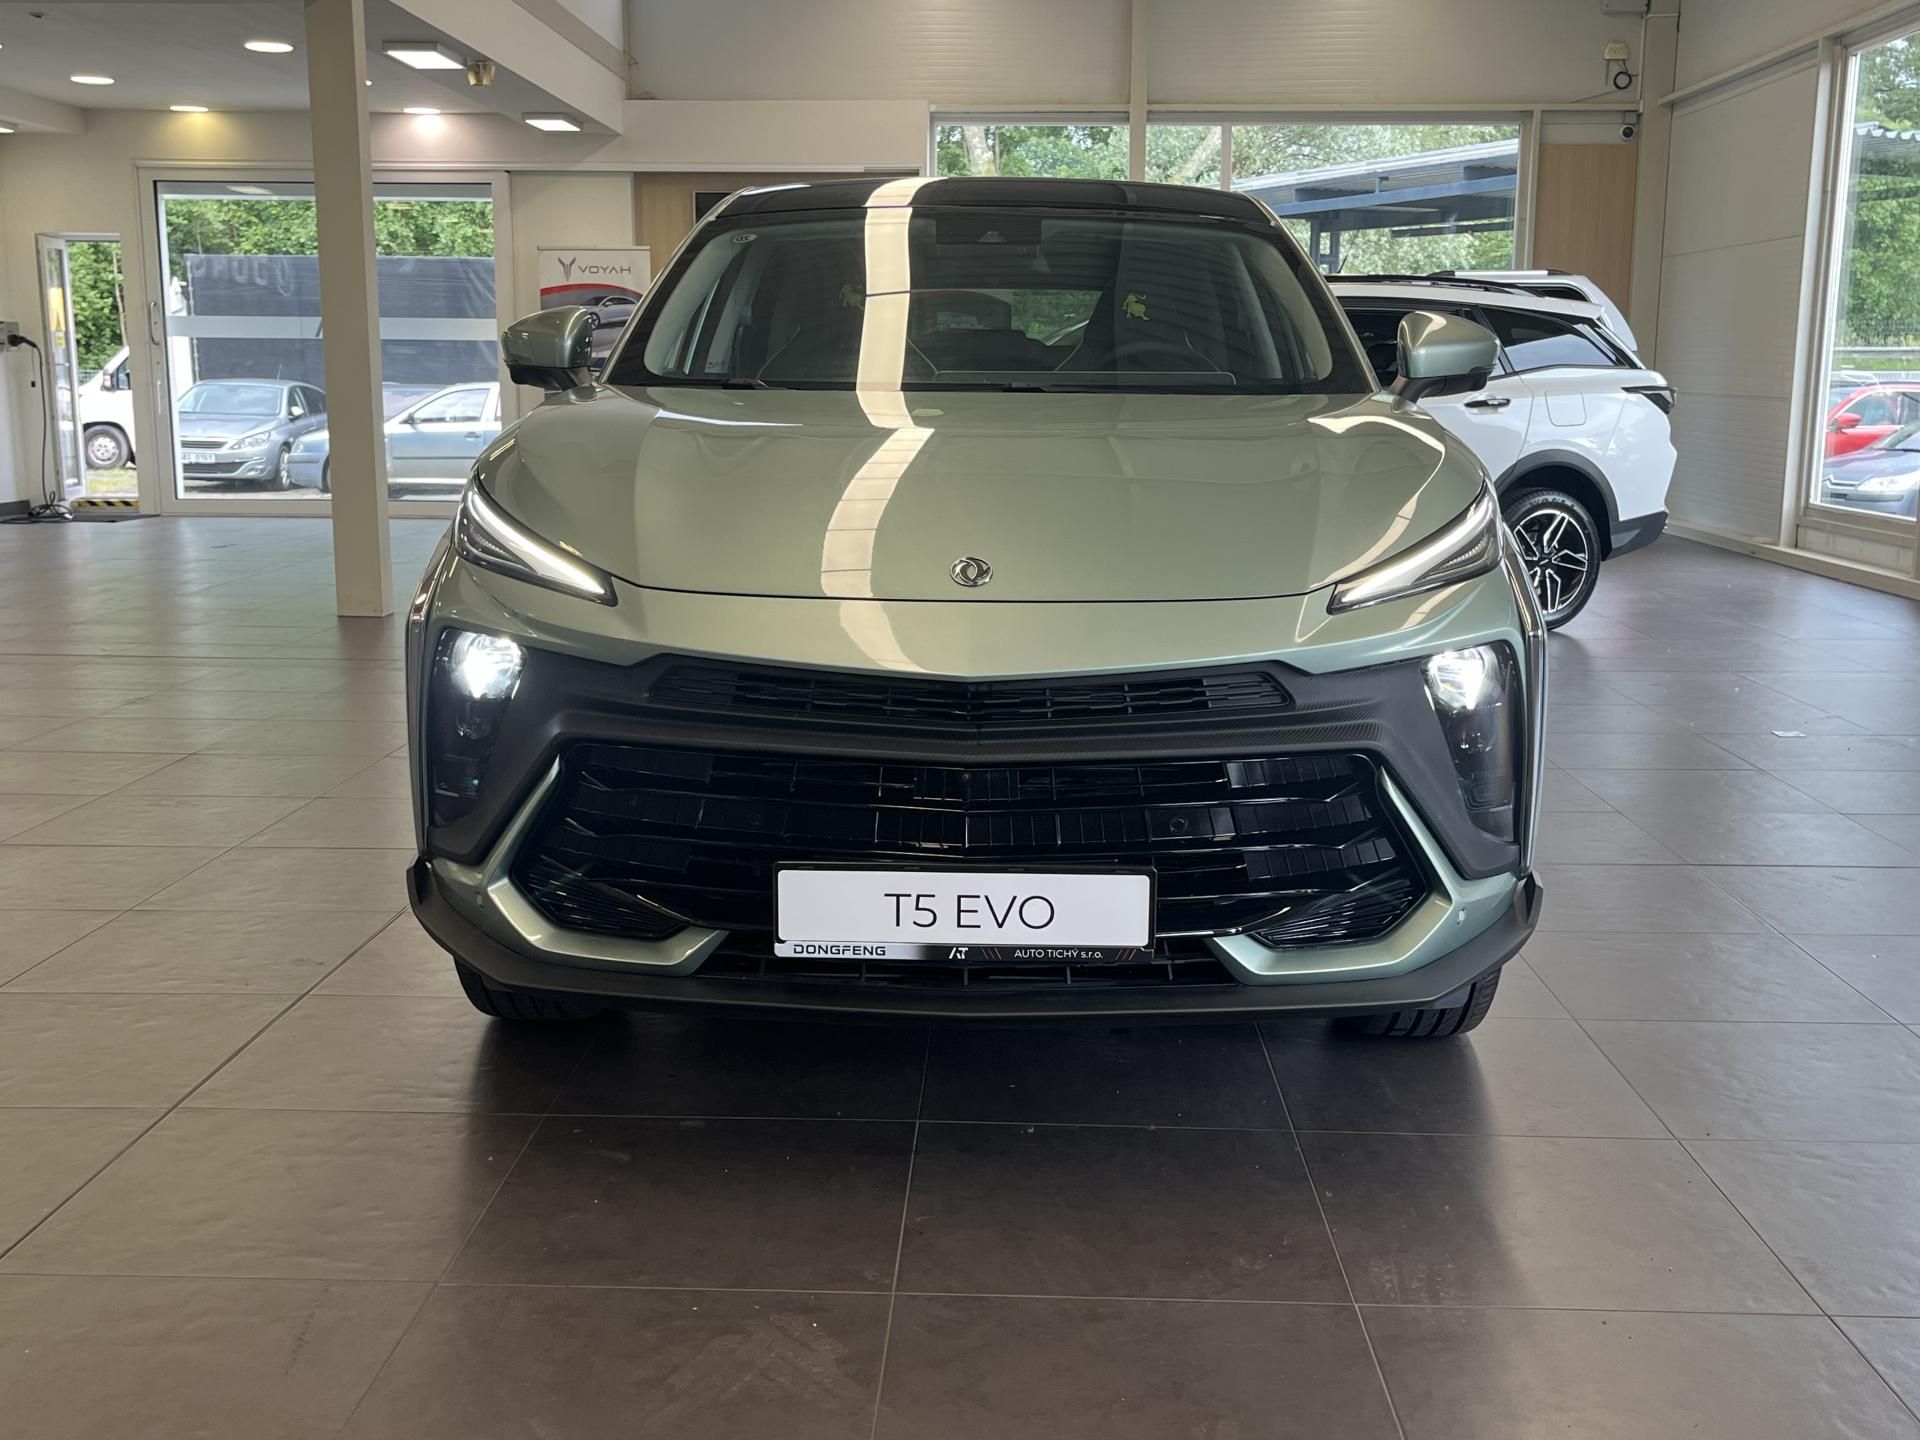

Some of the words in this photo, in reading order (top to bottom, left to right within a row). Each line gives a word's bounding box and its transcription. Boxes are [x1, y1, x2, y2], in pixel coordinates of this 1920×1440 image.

[578, 265, 631, 274] VOYAH
[883, 893, 938, 928] T5
[956, 895, 1055, 930] EVO
[793, 944, 886, 956] DONGFENG
[1014, 949, 1044, 958] AUTO
[1047, 948, 1079, 958] TICHÝ
[1080, 951, 1103, 959] s.r.o.
